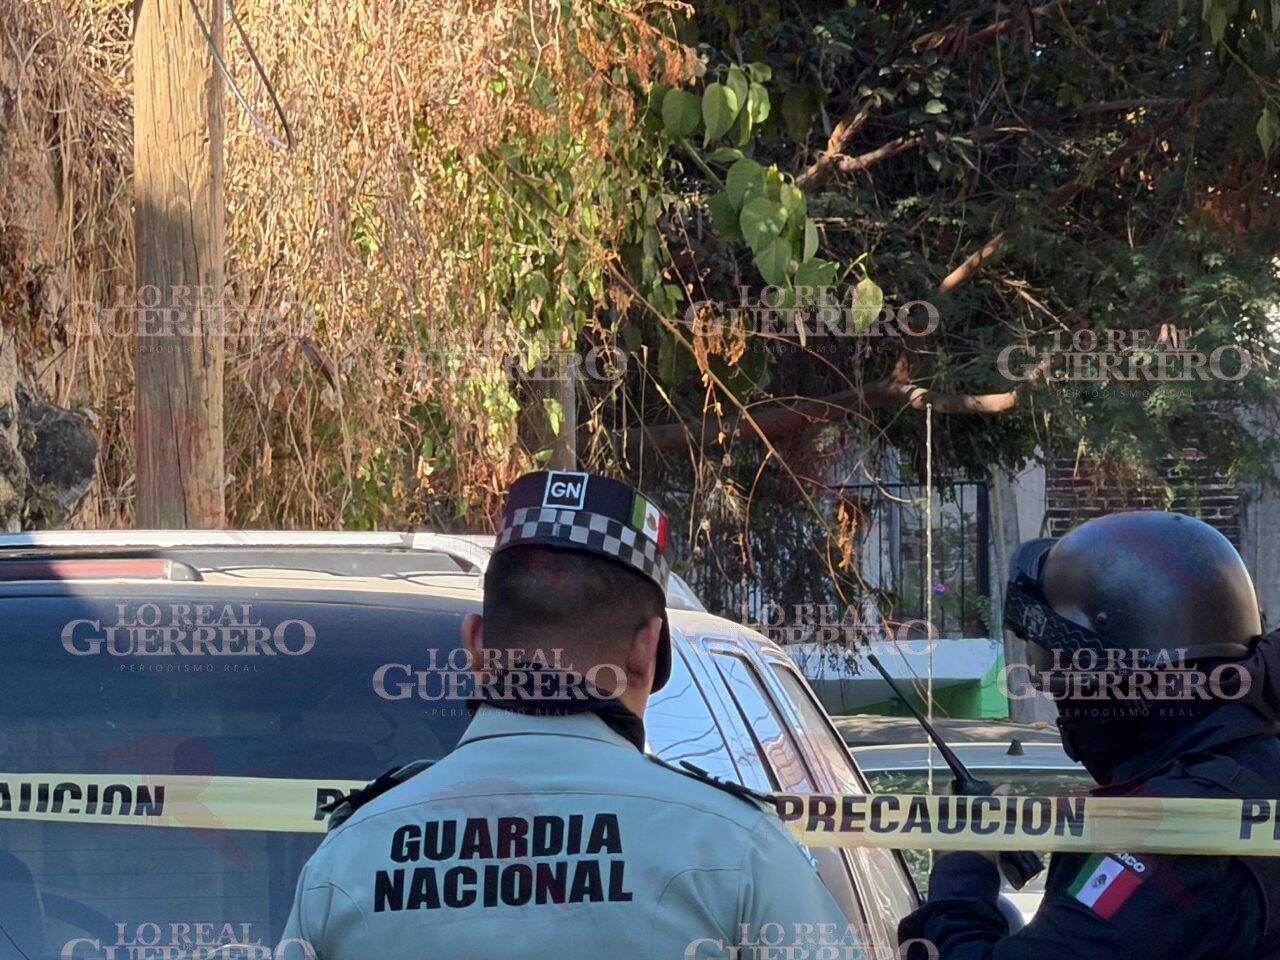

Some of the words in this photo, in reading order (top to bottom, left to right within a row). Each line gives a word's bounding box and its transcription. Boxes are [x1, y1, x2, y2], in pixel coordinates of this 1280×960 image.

[551, 482, 581, 498] GN
[390, 813, 623, 863] GUARDIA
[776, 795, 1087, 838] PRECAUCION
[374, 860, 633, 912] NACIONAL
